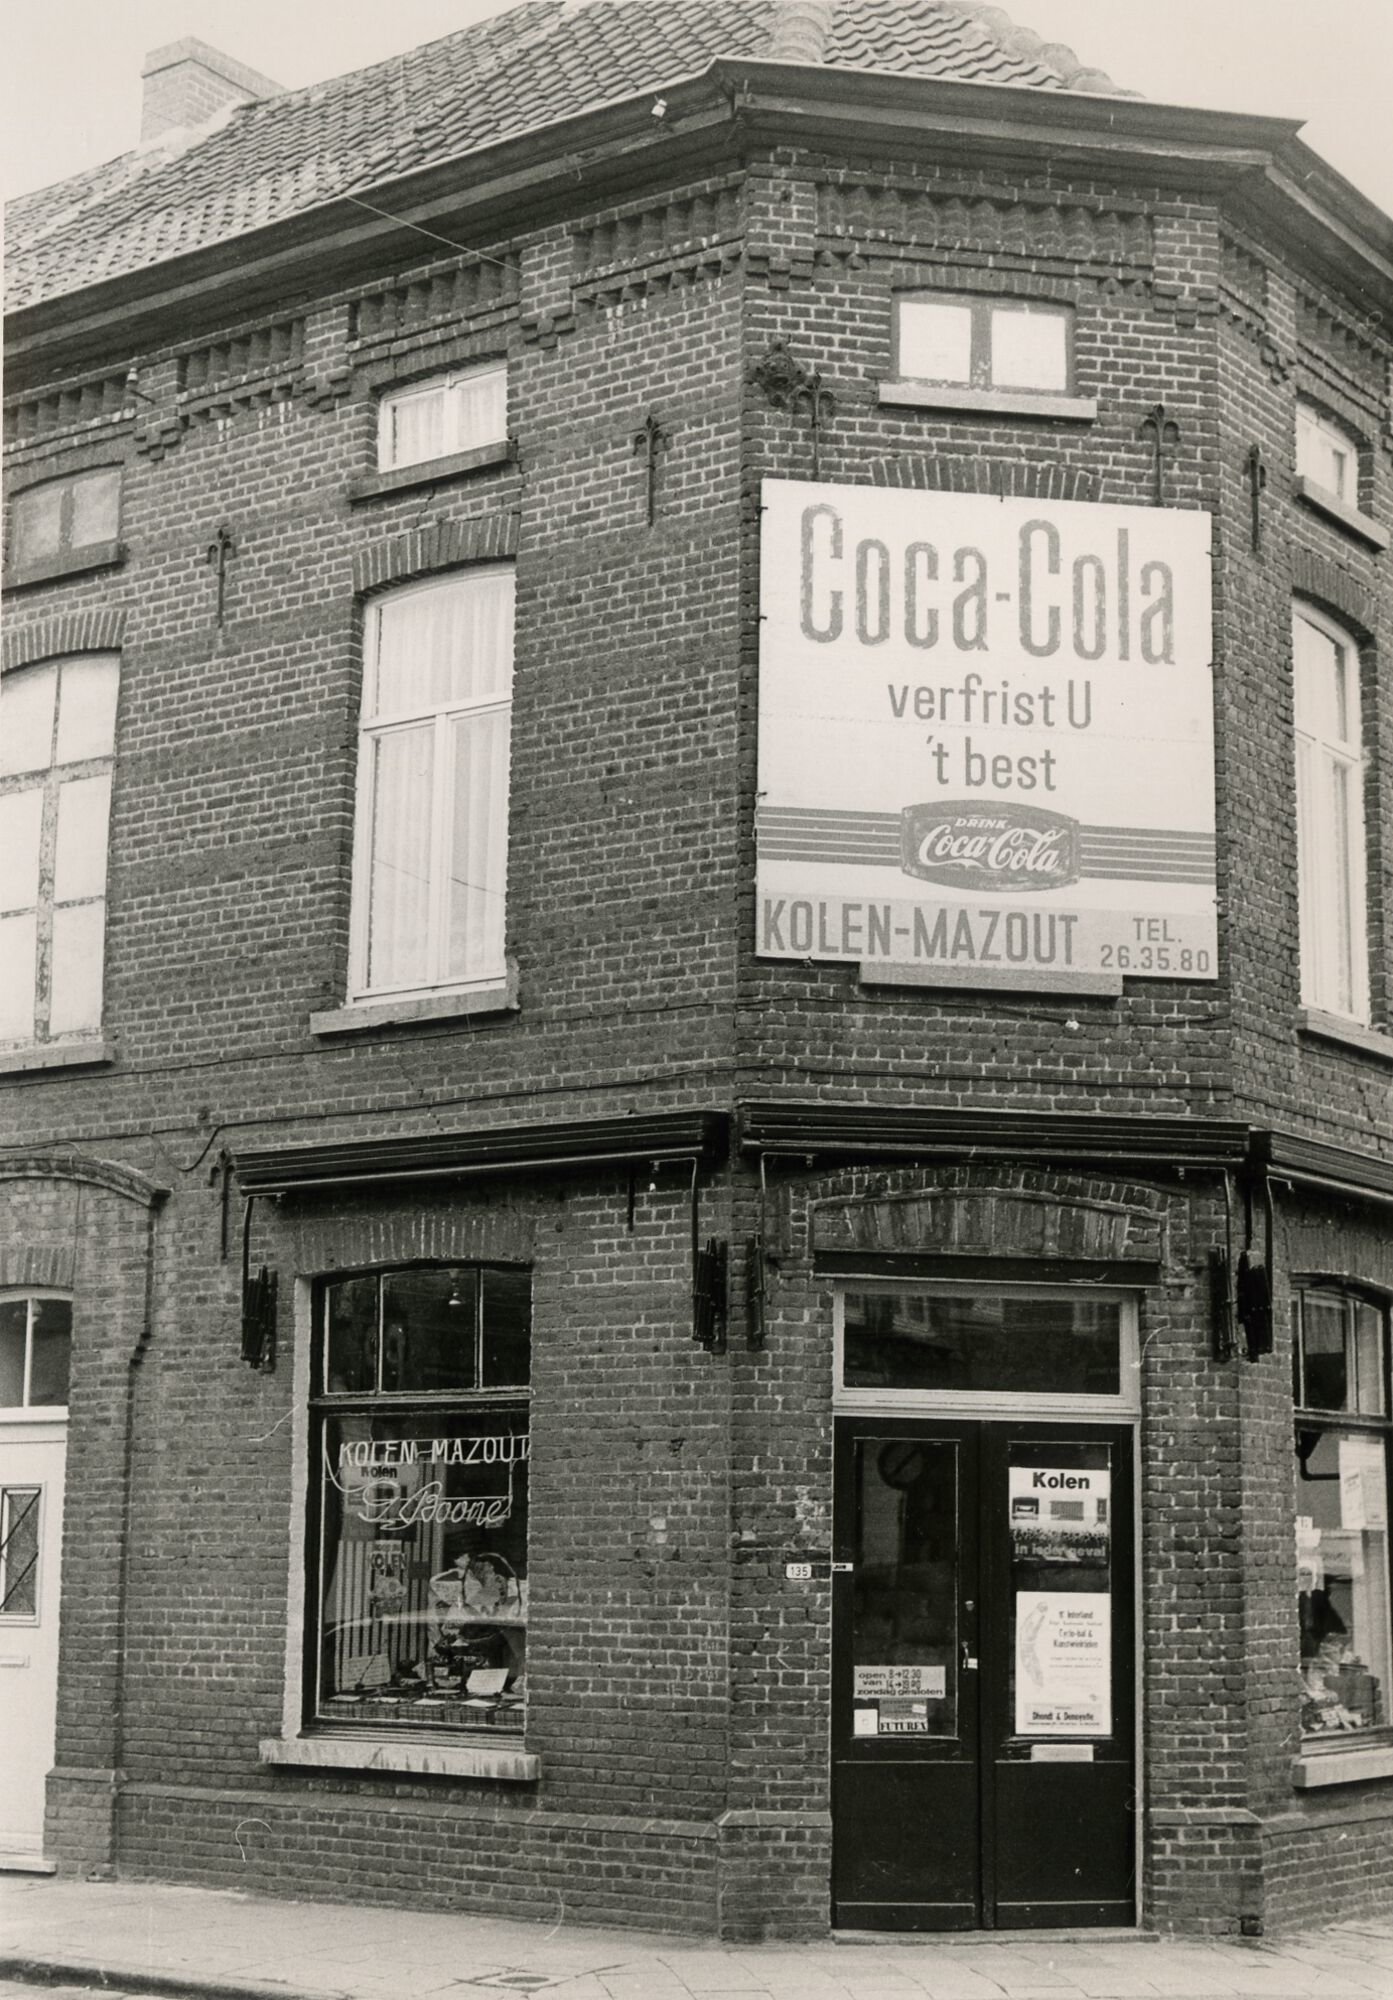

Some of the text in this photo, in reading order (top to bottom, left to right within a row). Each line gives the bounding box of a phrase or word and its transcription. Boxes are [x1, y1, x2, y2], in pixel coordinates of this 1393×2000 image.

[800, 502, 1175, 666] Coca-Cola
[888, 673, 1092, 729] verfrist U
[926, 735, 1057, 791] 't best
[954, 817, 1009, 830] DRINK
[918, 823, 1069, 872] Coca-Cola
[763, 899, 1078, 965] KOLEN-MAZOUT
[1132, 917, 1183, 943] TEL.
[1100, 944, 1210, 973] 26.35.80
[1033, 1472, 1089, 1490] Kolen
[1014, 1543, 1028, 1555] in
[790, 1565, 808, 1577] 135
[858, 1672, 887, 1680] open
[857, 1688, 896, 1697] zondag
